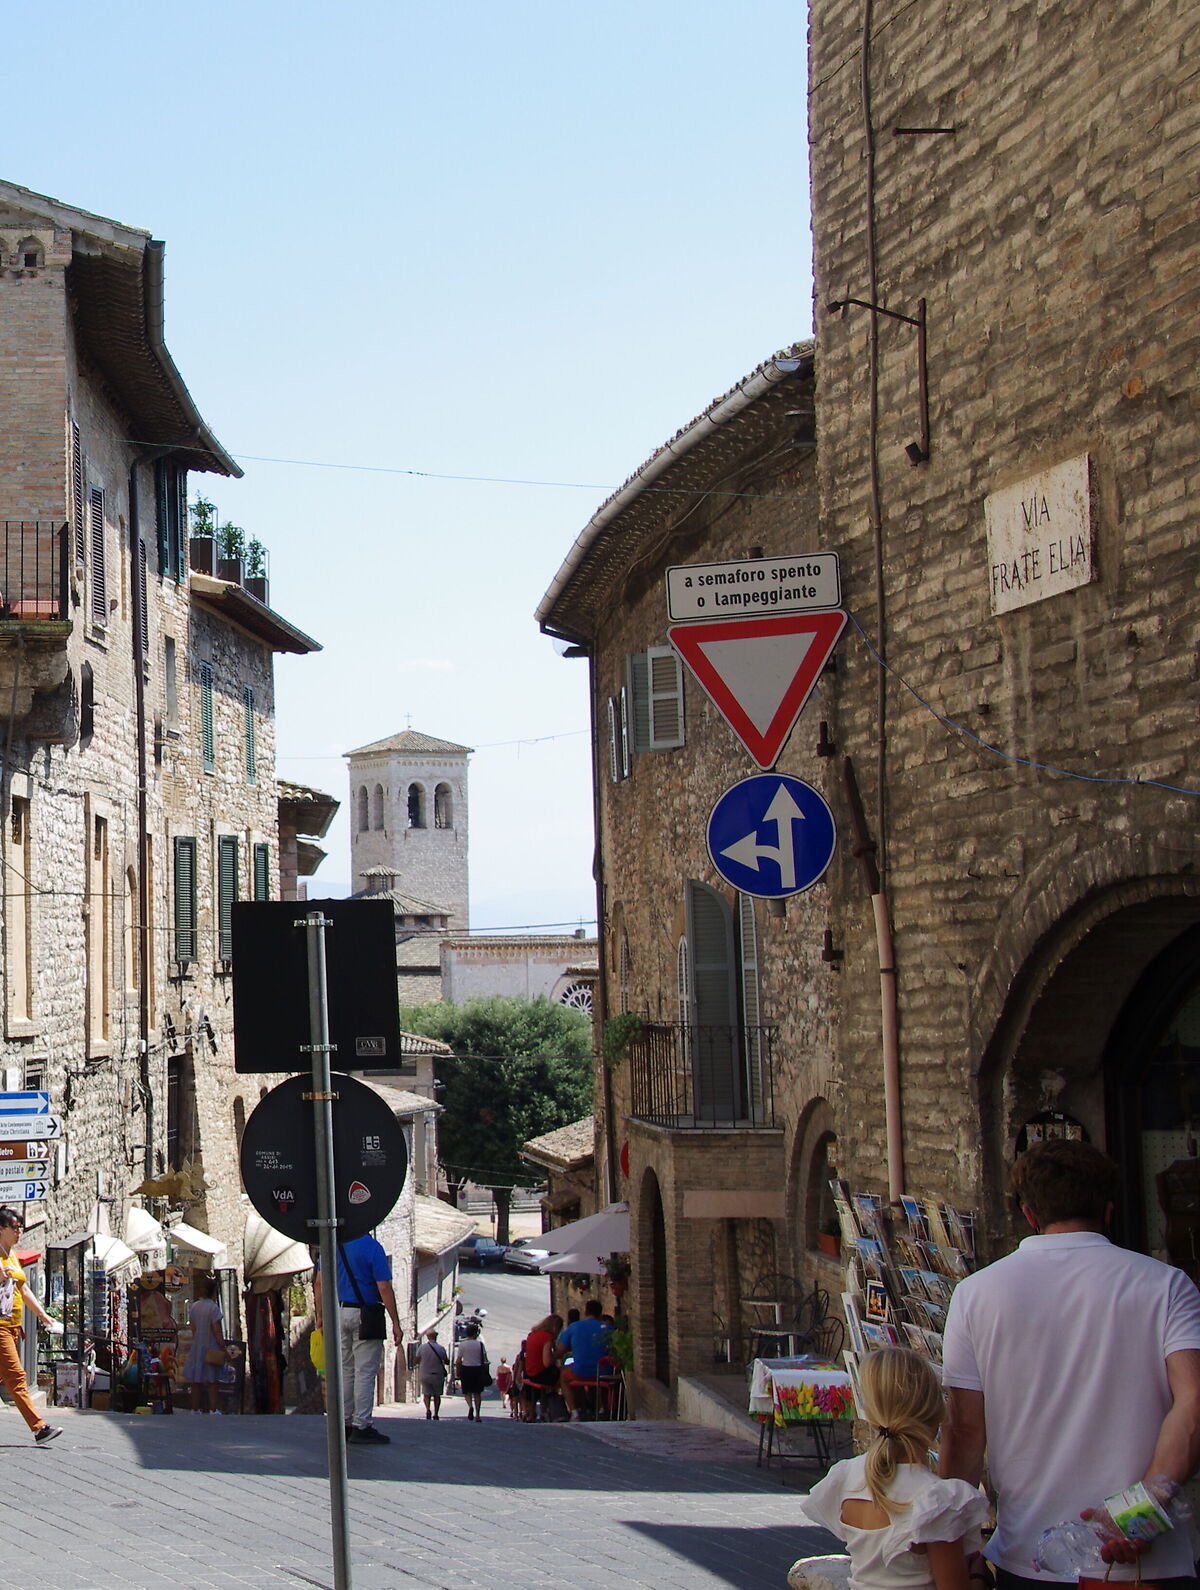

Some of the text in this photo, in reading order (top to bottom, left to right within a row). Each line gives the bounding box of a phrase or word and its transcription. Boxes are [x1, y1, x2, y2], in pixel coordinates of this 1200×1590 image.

[1021, 492, 1051, 528] VIA
[685, 563, 821, 588] a semaforo spento
[992, 535, 1086, 595] FRATE ELIA
[697, 585, 817, 608] o lampeggiante
[5, 1165, 24, 1176] postale
[272, 1190, 294, 1200] VdA
